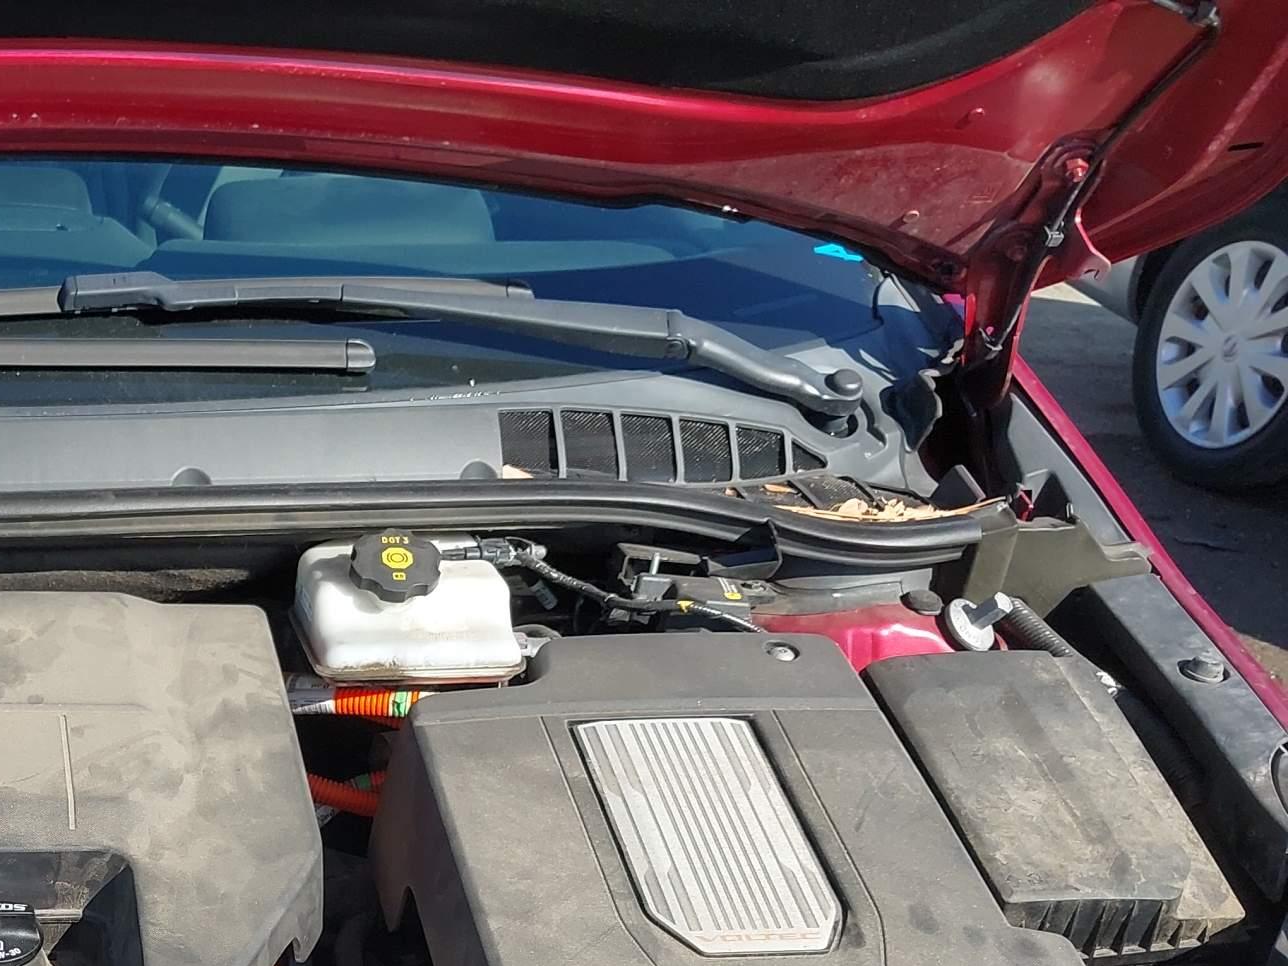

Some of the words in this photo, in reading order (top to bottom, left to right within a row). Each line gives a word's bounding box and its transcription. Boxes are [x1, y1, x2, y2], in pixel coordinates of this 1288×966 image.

[381, 536, 401, 544] DOT
[403, 536, 409, 544] 3
[694, 932, 822, 943] VOLTEC
